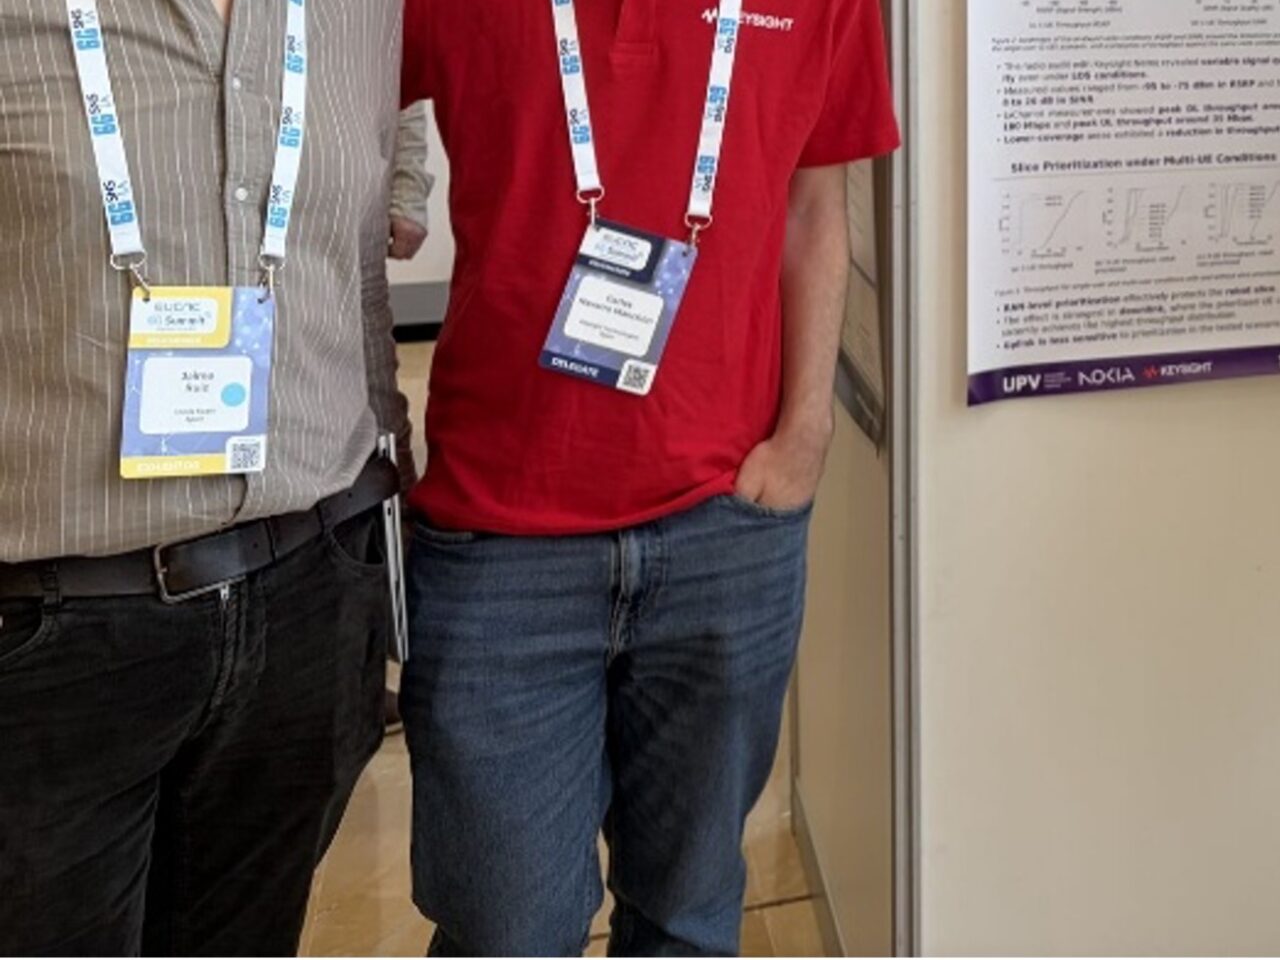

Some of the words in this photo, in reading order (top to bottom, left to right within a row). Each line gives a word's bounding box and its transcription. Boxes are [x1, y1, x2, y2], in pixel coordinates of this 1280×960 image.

[739, 11, 794, 32] YSIGHT
[73, 27, 101, 51] 6G
[90, 113, 117, 136] 6G
[279, 126, 301, 148] 6G
[1010, 160, 1040, 174] Slice
[1042, 157, 1123, 172] Prioritization
[1125, 155, 1161, 168] under
[1215, 151, 1278, 165] Conditions
[107, 200, 134, 226] 6G
[268, 205, 289, 228] 6G
[551, 356, 599, 379] DELEGATE
[1002, 373, 1042, 393] UPV
[1077, 366, 1136, 387] NOKIA
[1160, 360, 1213, 376] KEYSIGHT
